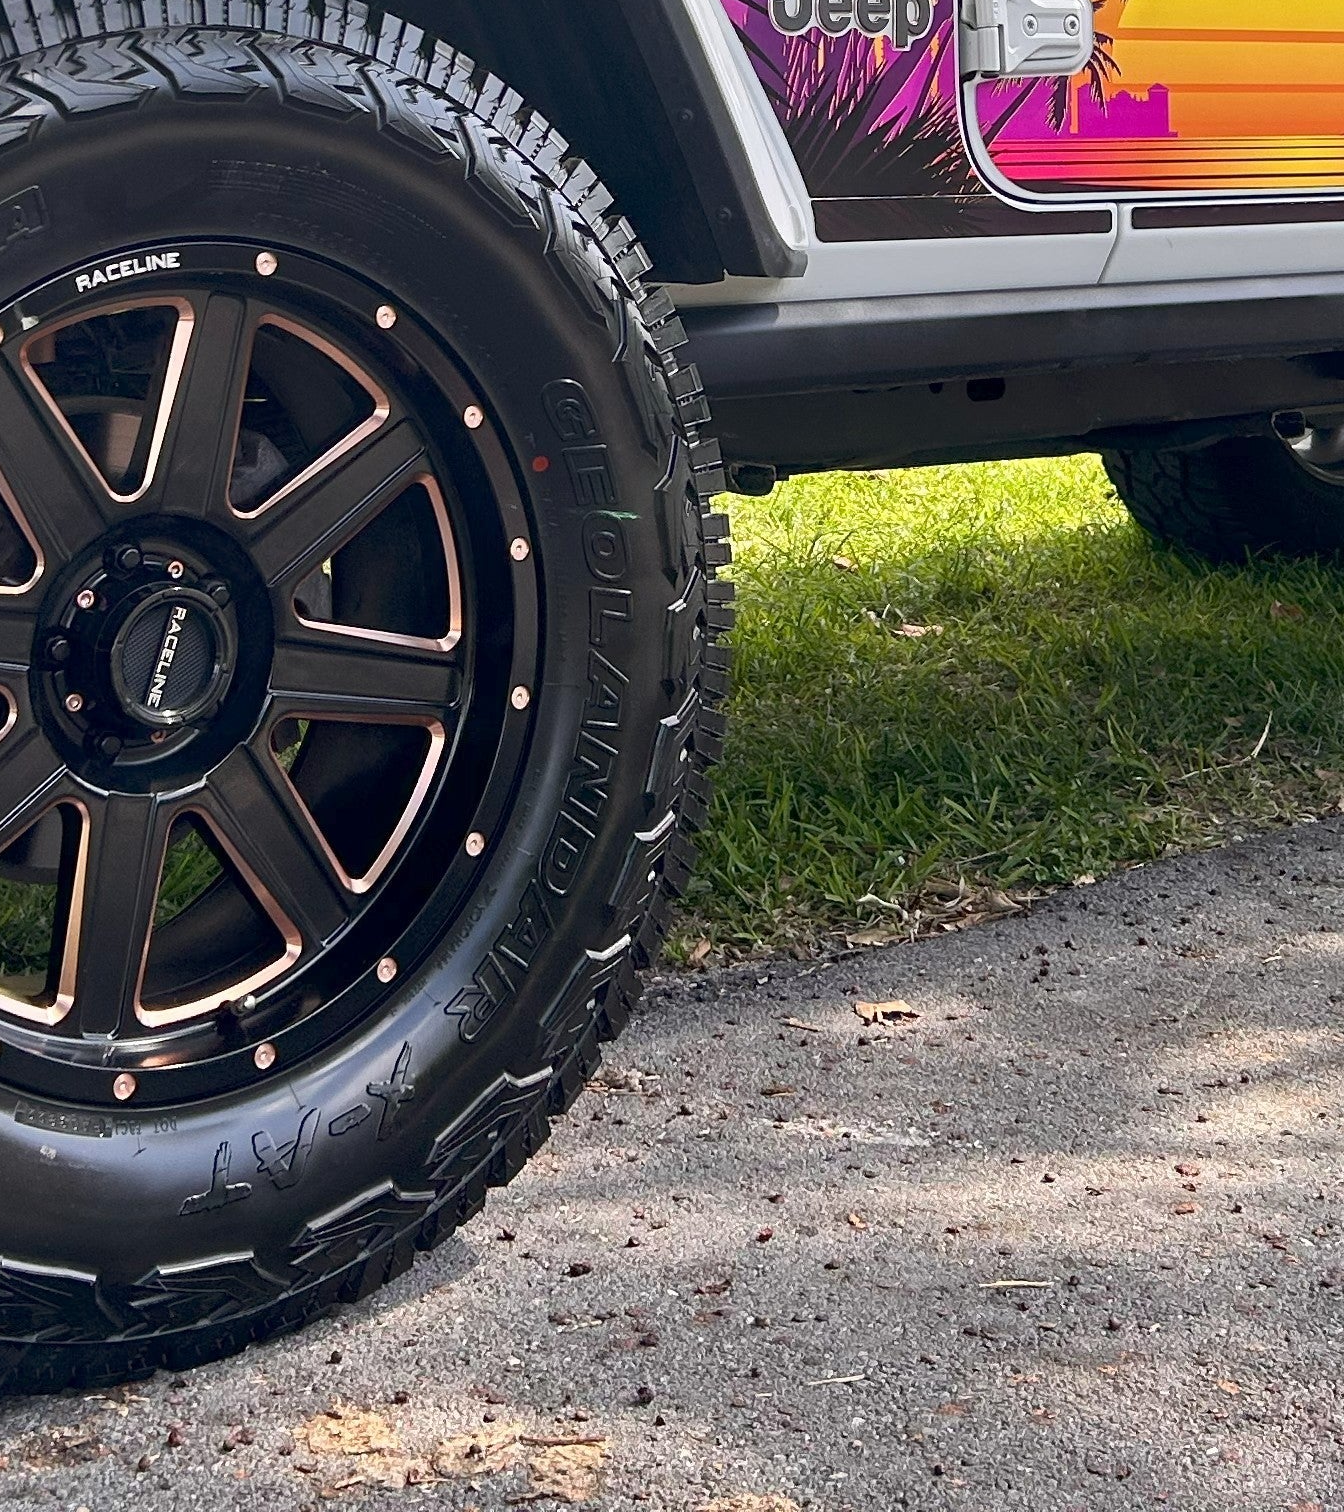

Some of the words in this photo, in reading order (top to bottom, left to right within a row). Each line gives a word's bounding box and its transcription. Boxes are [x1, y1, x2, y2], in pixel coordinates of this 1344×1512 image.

[75, 252, 181, 293] RACELINE
[146, 606, 188, 708] RACELINE
[442, 376, 634, 1043] GEOLANDAR
